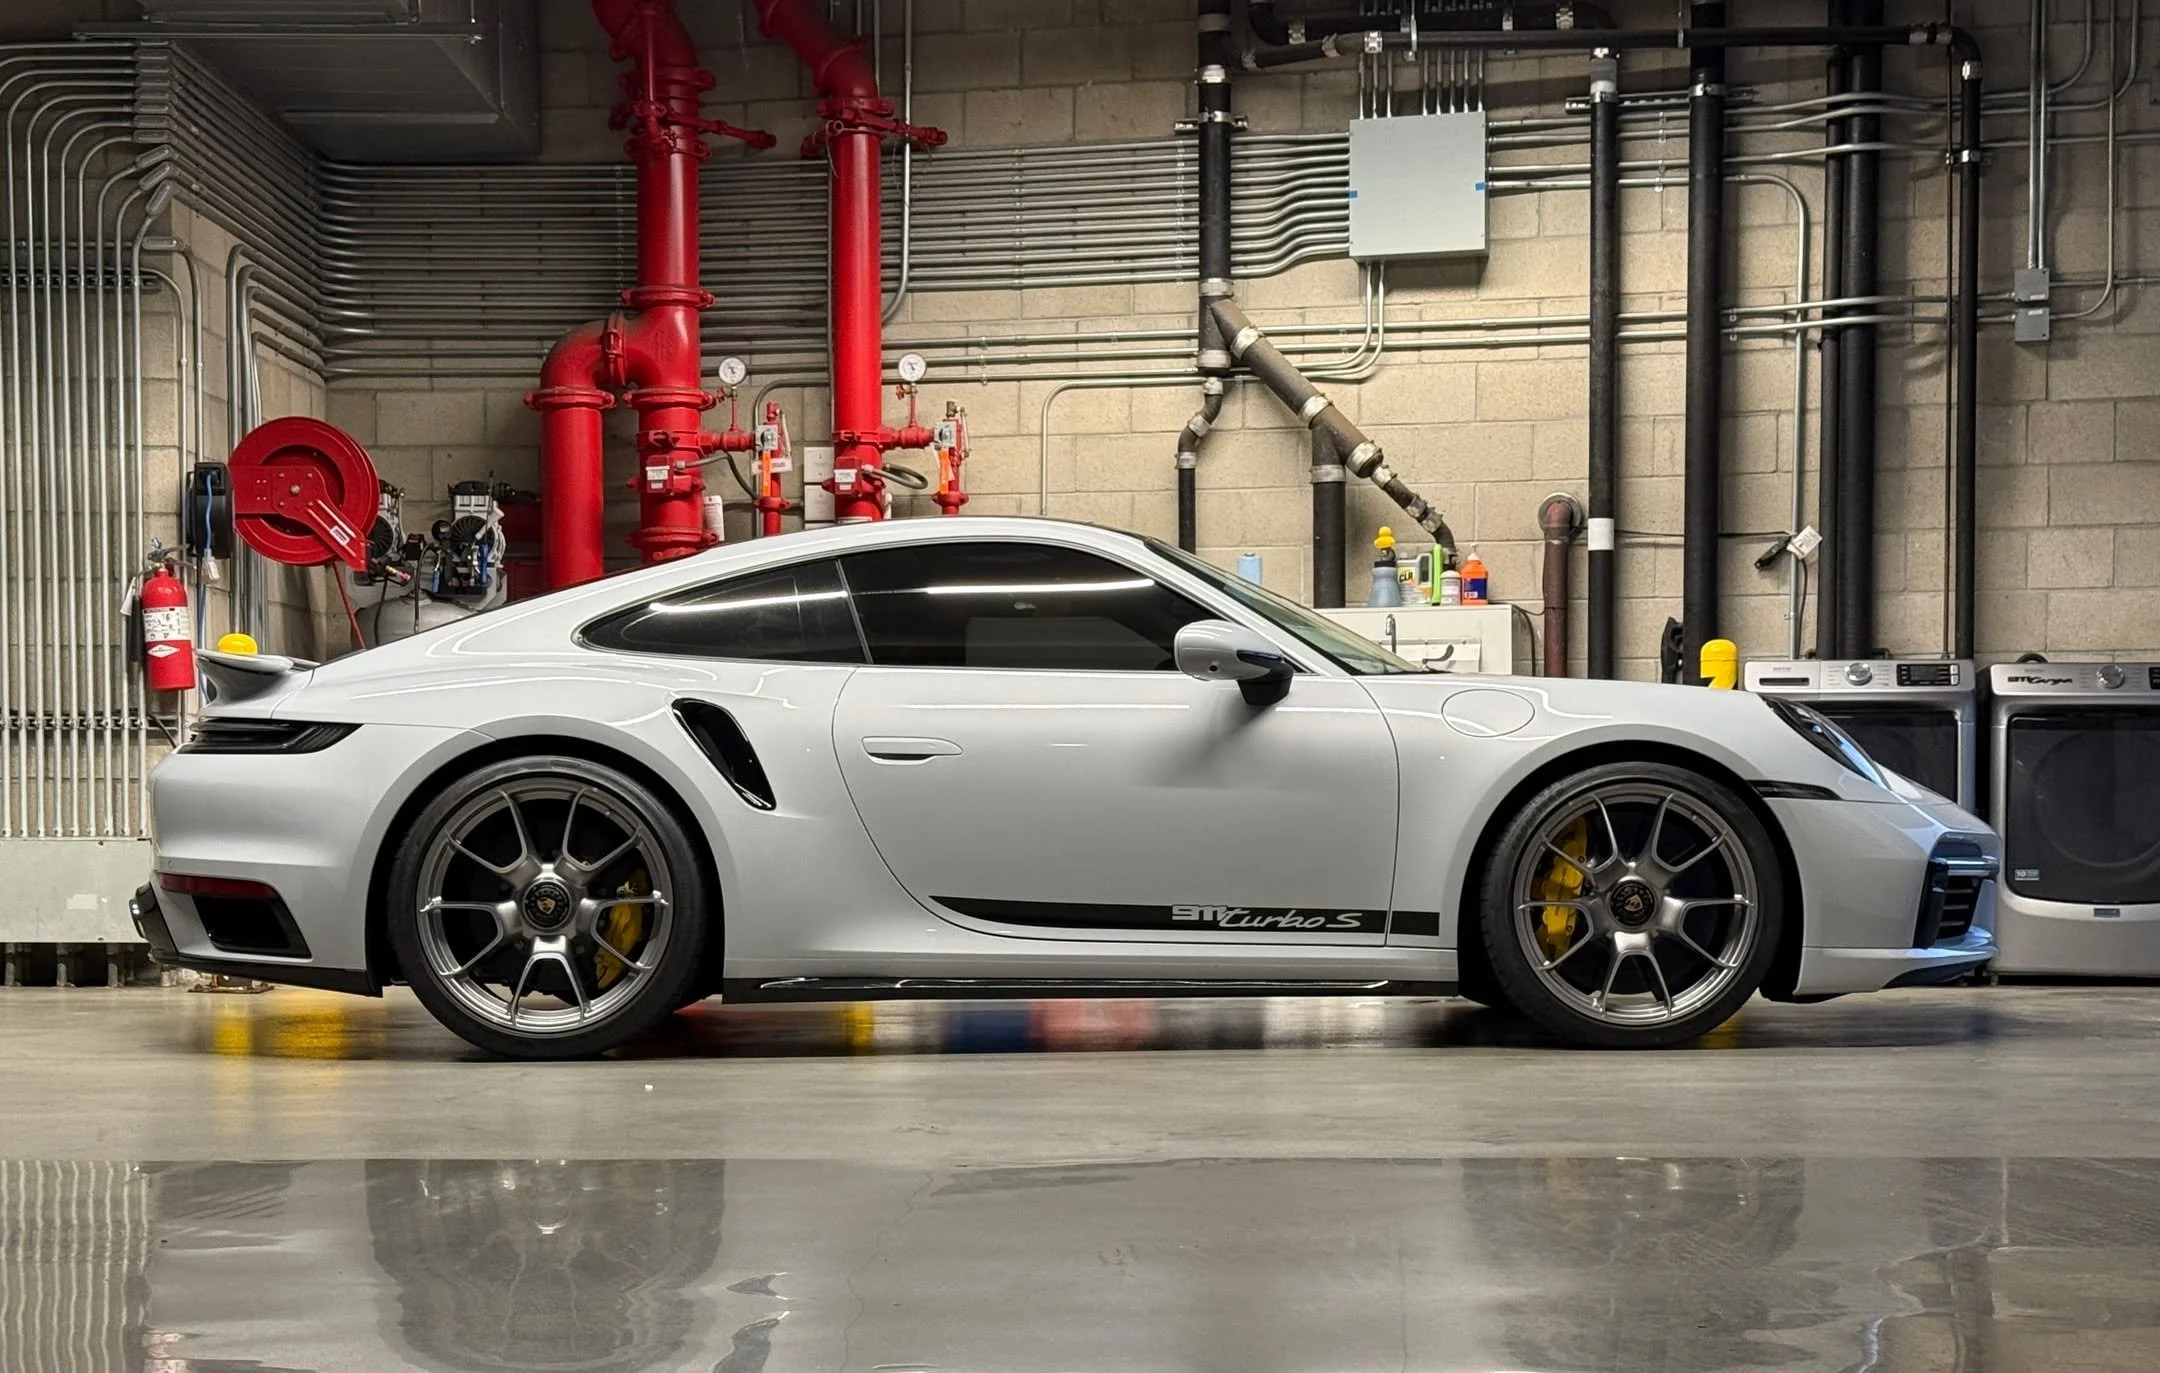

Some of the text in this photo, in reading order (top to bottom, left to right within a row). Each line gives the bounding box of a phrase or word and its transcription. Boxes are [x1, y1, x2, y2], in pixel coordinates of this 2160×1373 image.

[1399, 572, 1413, 582] CLR
[1172, 905, 1228, 921] 911
[1325, 912, 1363, 928] S
